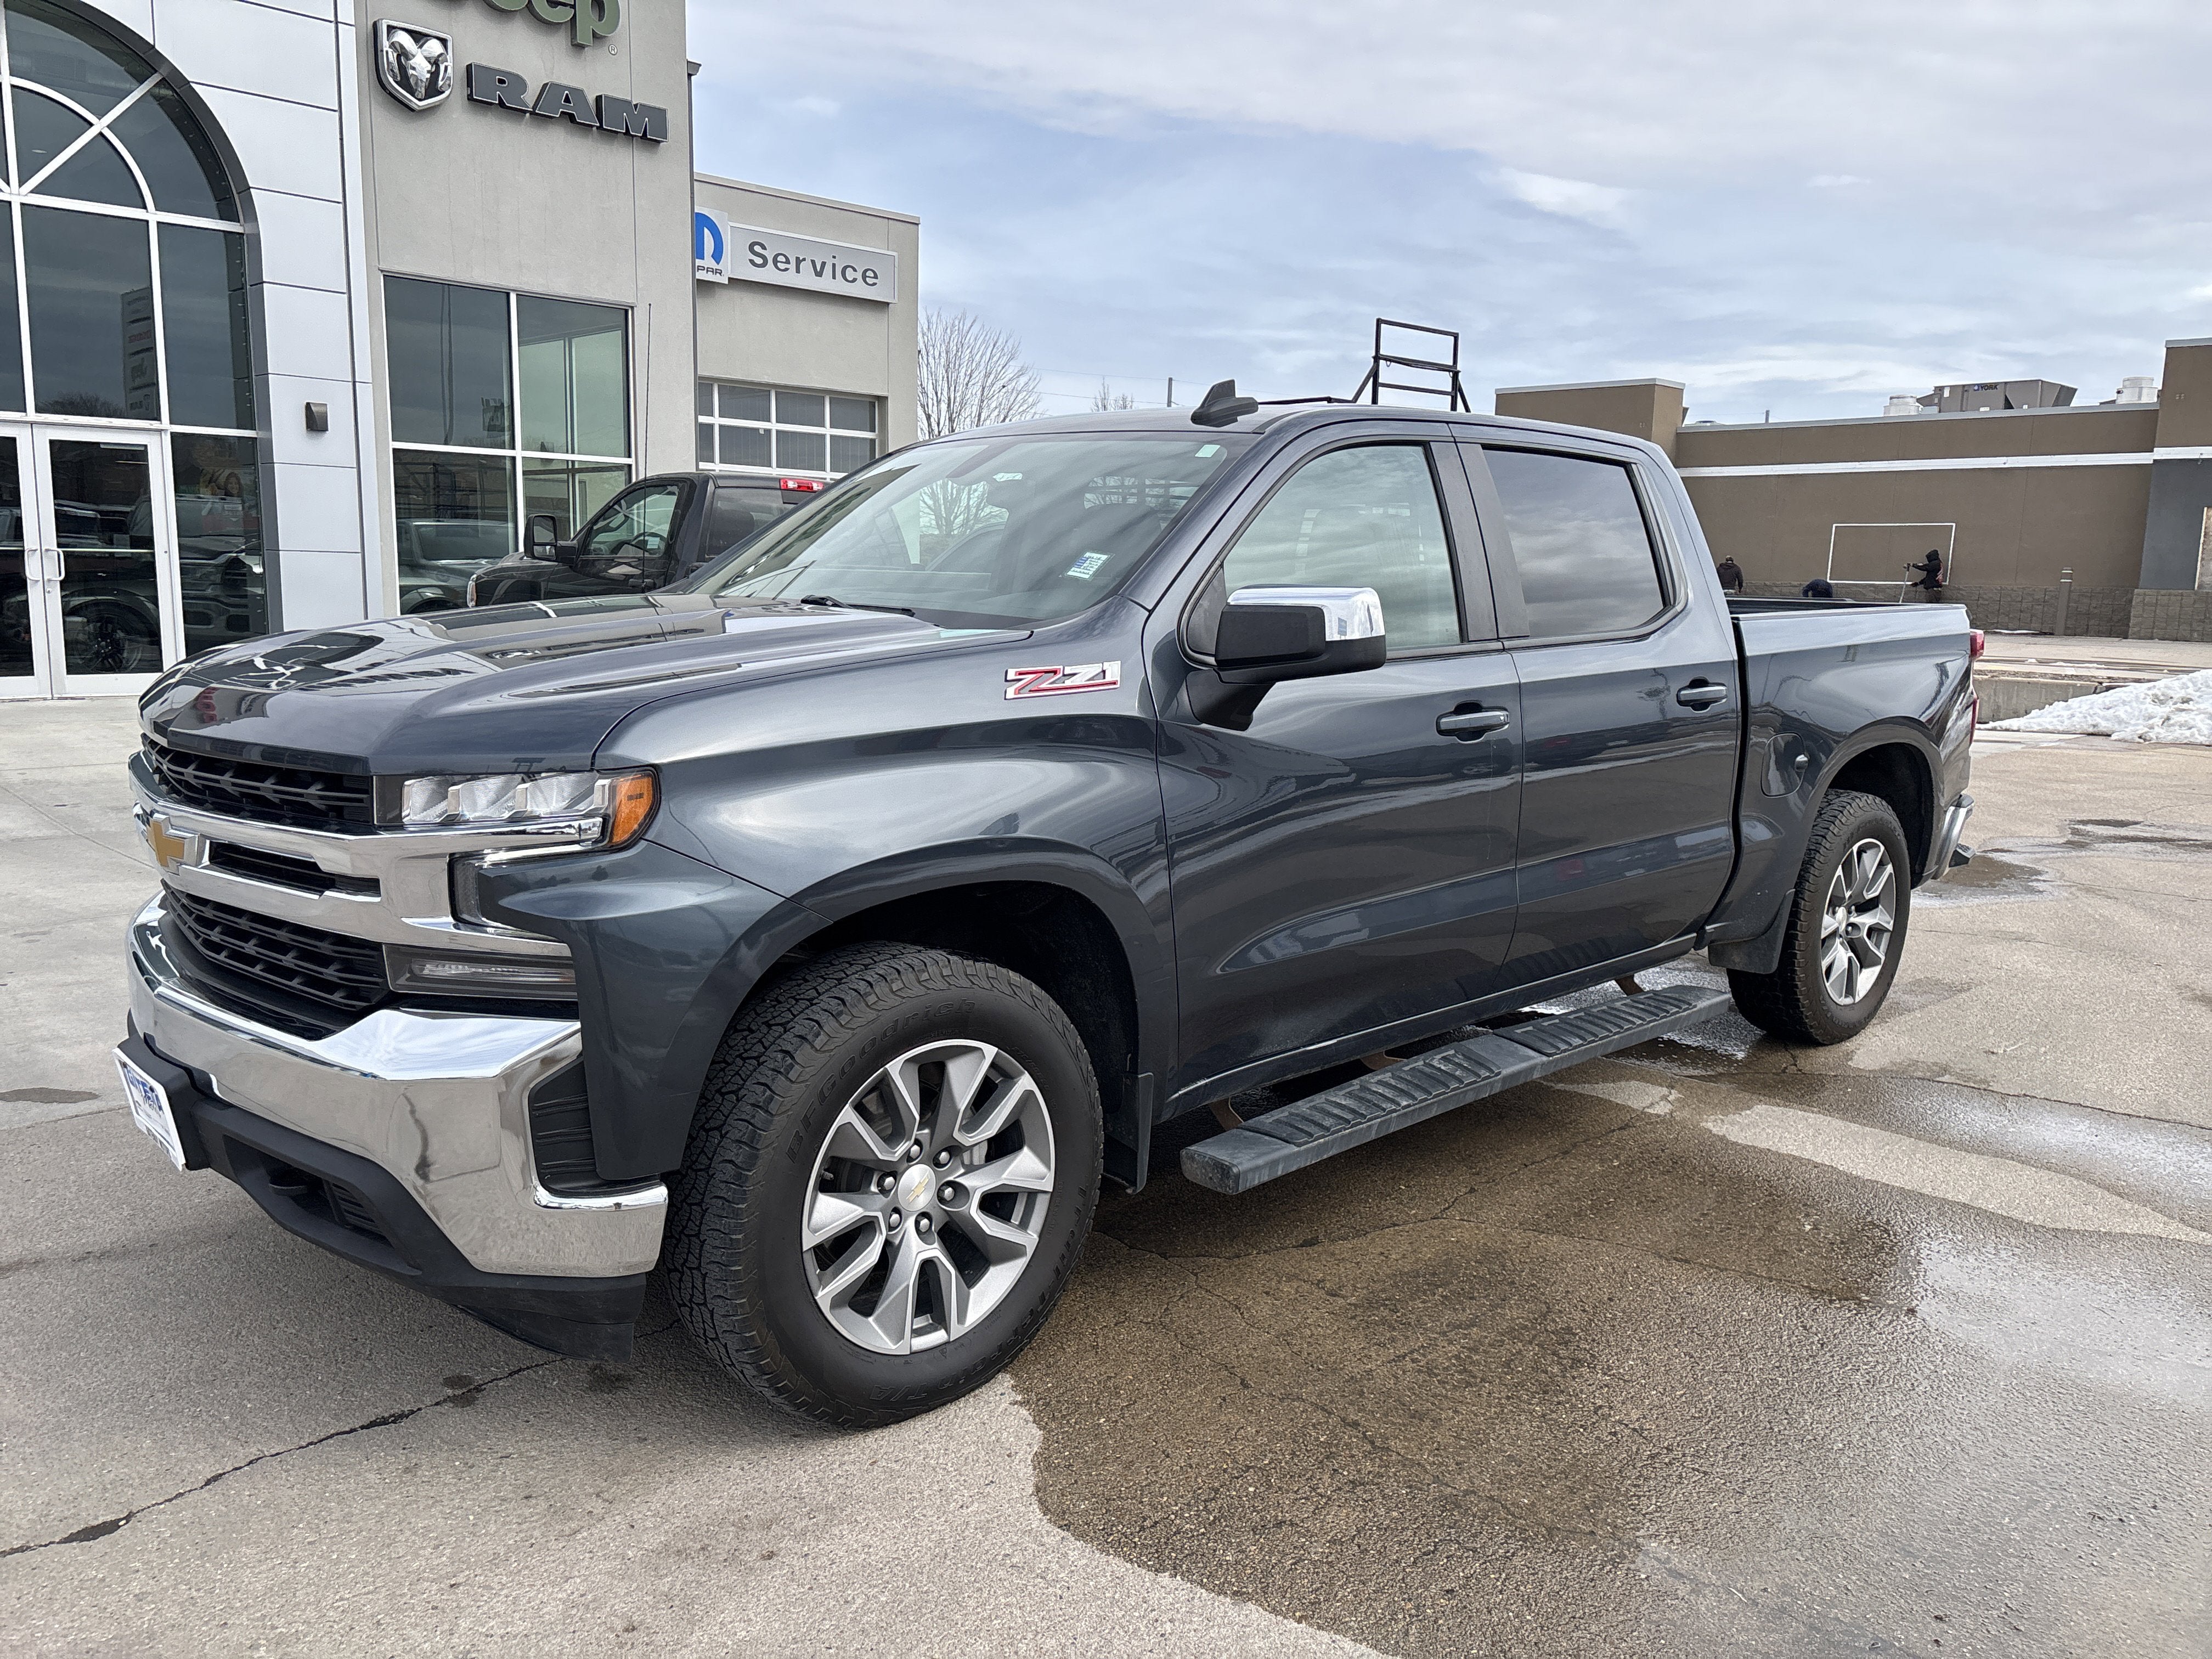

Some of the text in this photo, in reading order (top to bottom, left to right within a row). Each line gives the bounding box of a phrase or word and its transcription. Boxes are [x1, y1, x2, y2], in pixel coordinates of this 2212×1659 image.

[467, 62, 669, 143] RAM
[748, 241, 879, 286] Service
[1005, 661, 1121, 701] Z71
[786, 998, 975, 1164] BFGoodrich
